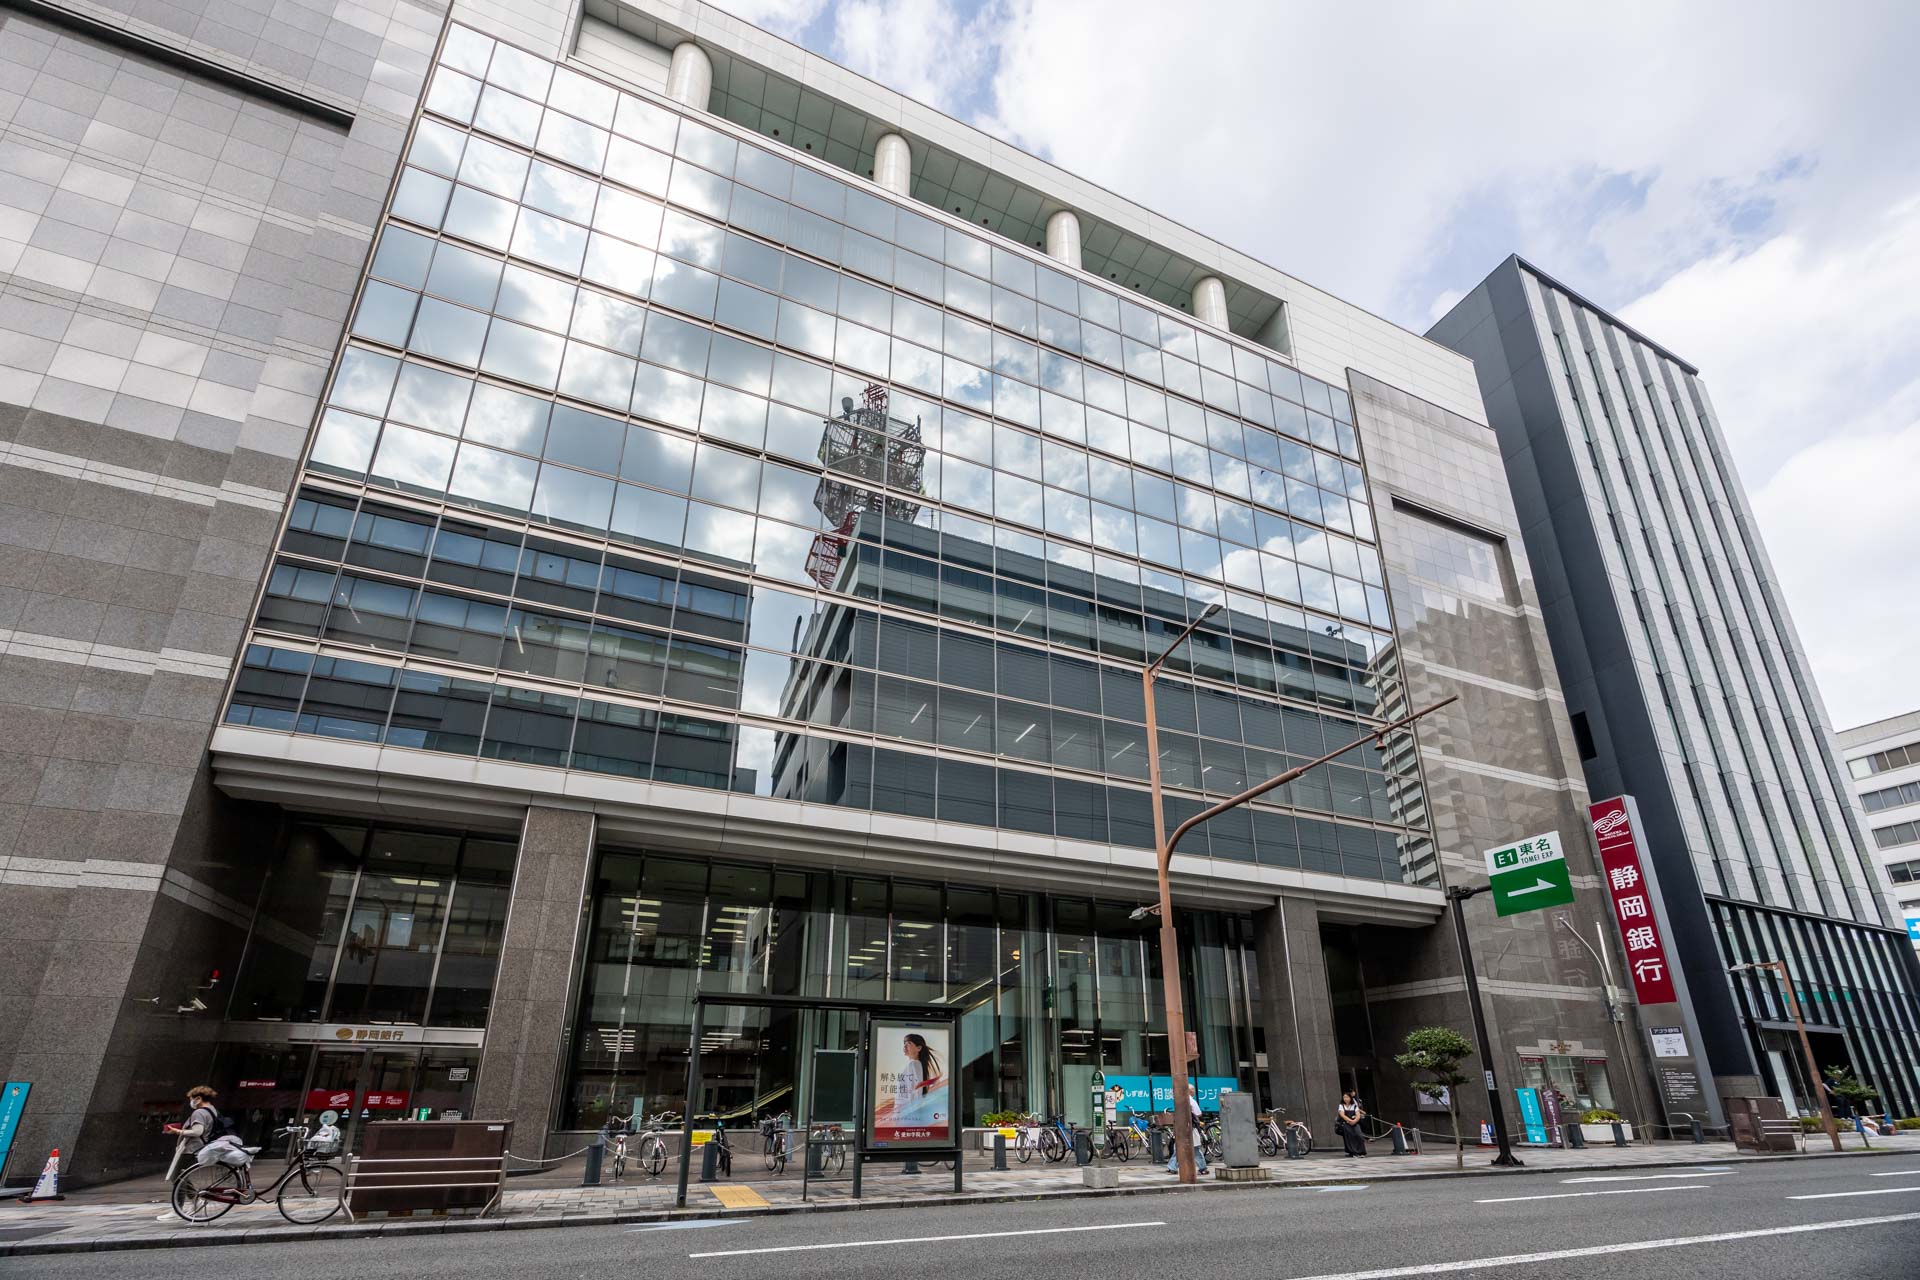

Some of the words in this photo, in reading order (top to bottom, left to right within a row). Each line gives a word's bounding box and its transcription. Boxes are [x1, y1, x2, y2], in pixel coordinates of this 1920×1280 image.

[1518, 838, 1551, 856] 東名
[1498, 853, 1514, 865] E1
[1520, 854, 1540, 865] TOMEI
[1542, 851, 1554, 860] EXP
[1610, 865, 1663, 983] 静岡銀行
[356, 1029, 404, 1040] 静岡銀行
[880, 1072, 918, 1082] 解き放て、
[1125, 1089, 1149, 1098] しずぎん
[1153, 1087, 1218, 1100] 相談ンジ
